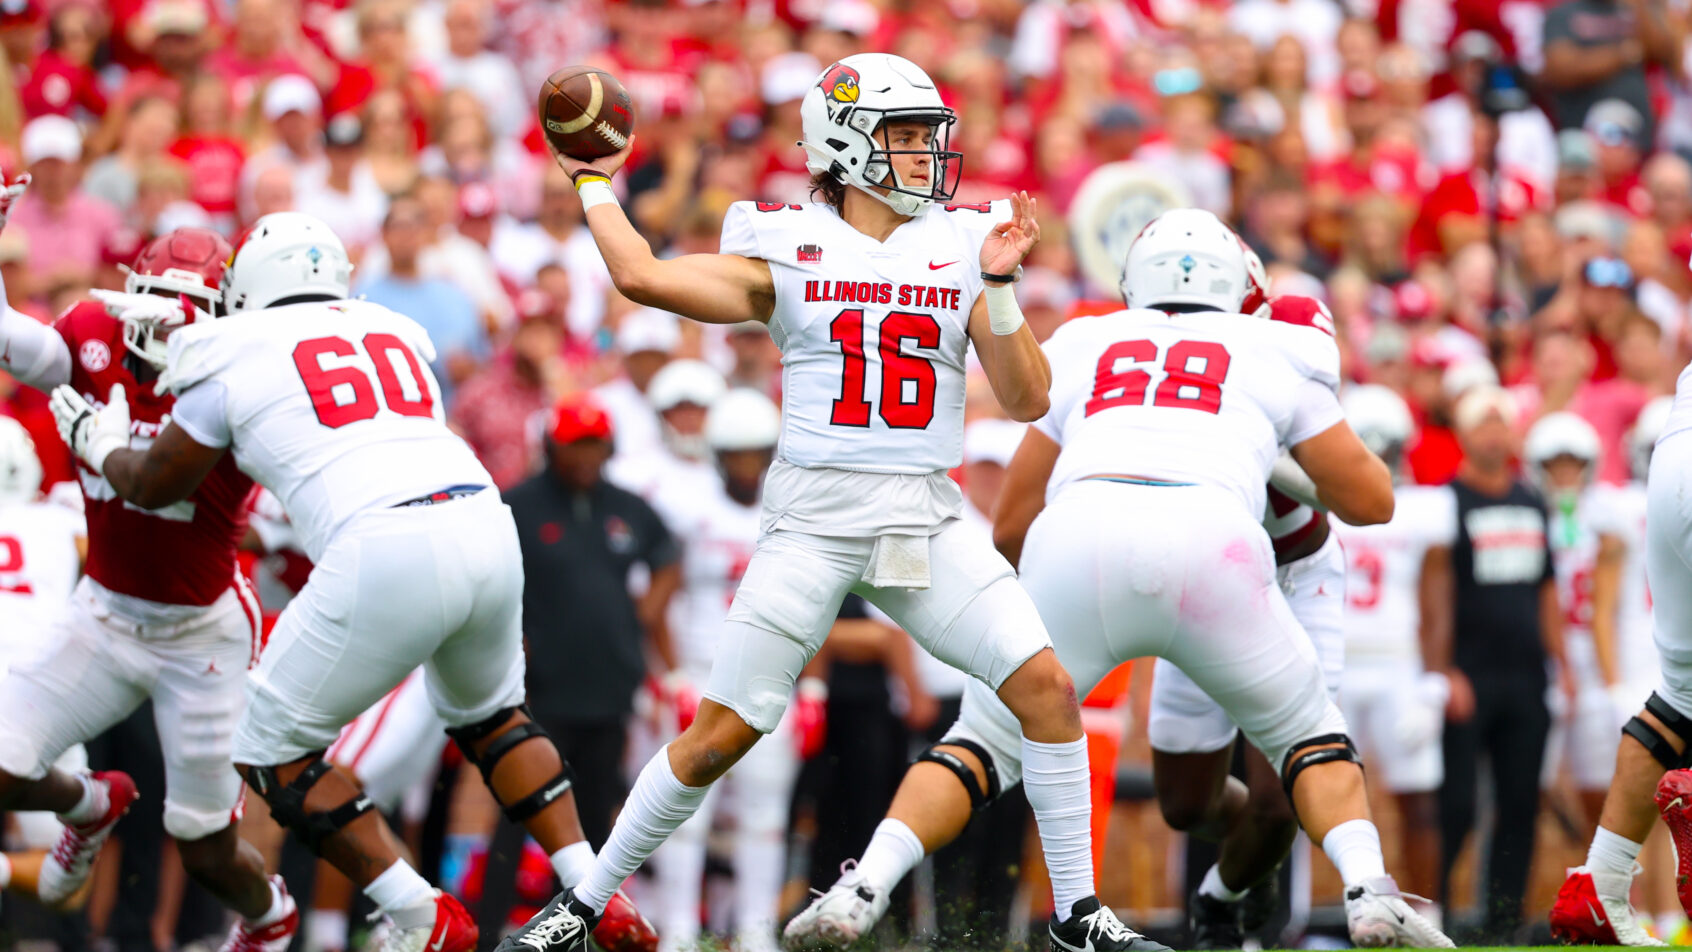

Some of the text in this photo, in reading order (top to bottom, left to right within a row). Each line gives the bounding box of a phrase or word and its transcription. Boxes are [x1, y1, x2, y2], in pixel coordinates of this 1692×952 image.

[805, 280, 961, 311] ILLINOIS STATE
[291, 332, 434, 429] 60
[830, 308, 941, 430] 16
[1084, 339, 1231, 418] 68
